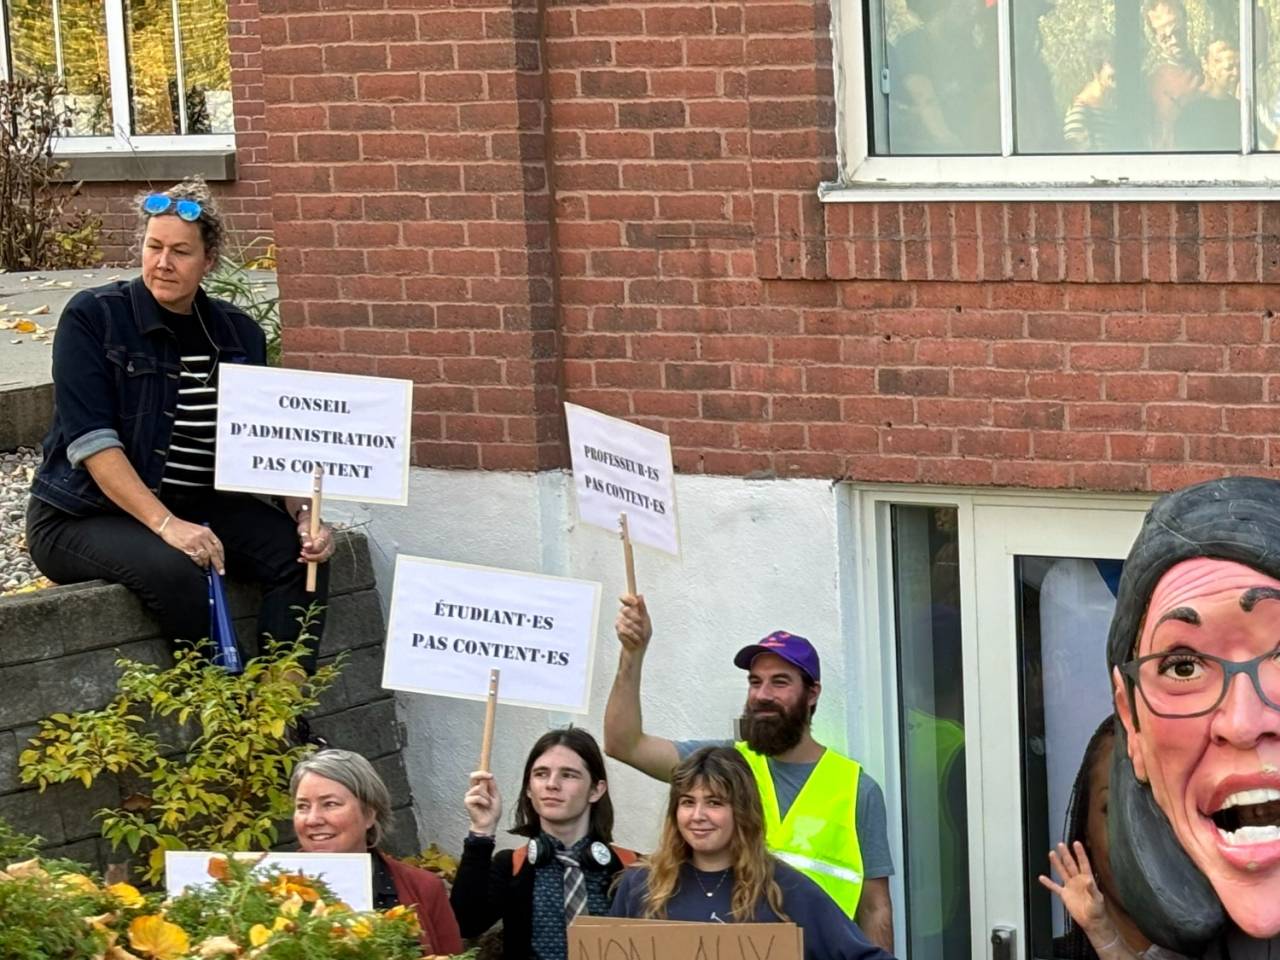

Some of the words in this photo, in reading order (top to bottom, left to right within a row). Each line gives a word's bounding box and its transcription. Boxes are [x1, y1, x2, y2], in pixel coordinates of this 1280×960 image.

[278, 395, 351, 414] CONSEIL
[252, 455, 286, 471] PAS
[585, 475, 605, 493] PAS
[411, 633, 449, 651] PAS
